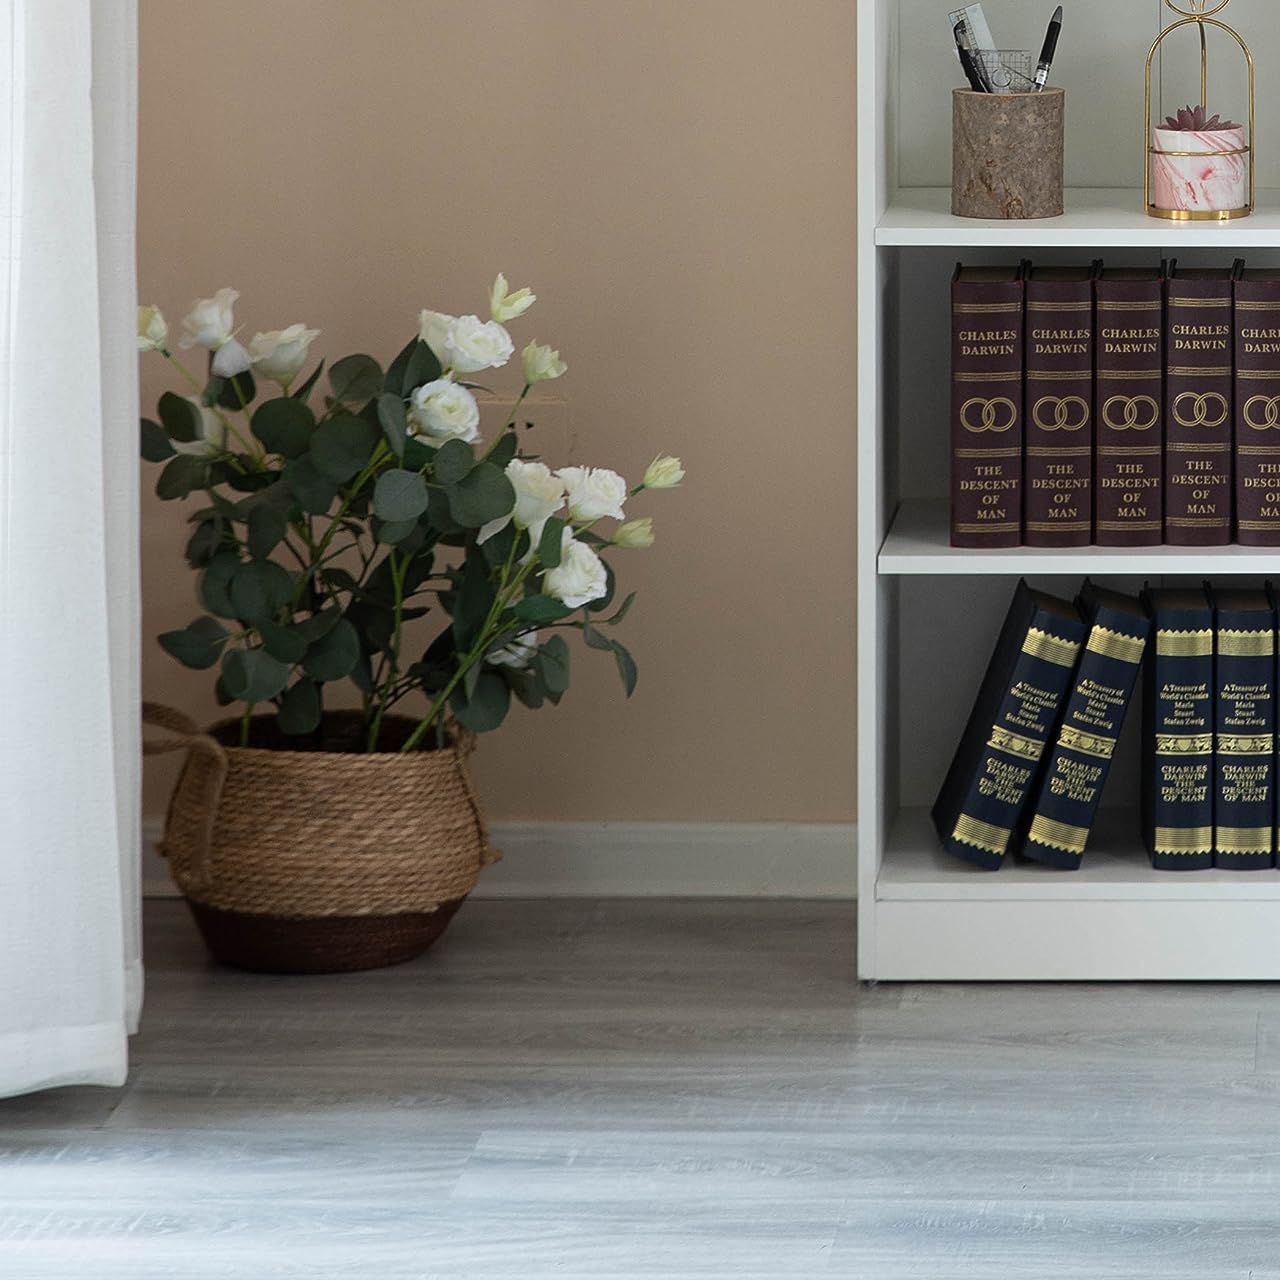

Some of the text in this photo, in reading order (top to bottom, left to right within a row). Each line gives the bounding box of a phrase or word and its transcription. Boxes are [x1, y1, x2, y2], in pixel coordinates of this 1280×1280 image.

[1033, 329, 1090, 338] CHARLES
[1102, 329, 1159, 338] CHARLES
[1172, 325, 1228, 334] CHARLES
[960, 331, 1016, 340] CHARLES
[1036, 344, 1087, 353] DARWIN
[1105, 344, 1156, 352] DARWIN
[1176, 340, 1225, 349] DARWIN
[963, 345, 1013, 354] DARWIN
[1047, 465, 1073, 474] THE
[1117, 465, 1143, 473] THE
[1187, 461, 1212, 469] THE
[975, 466, 1002, 475] THE
[1033, 479, 1088, 488] DESCENT
[1102, 479, 1159, 487] DESCENT
[1172, 475, 1225, 484] DESCENT
[961, 480, 1018, 489] DESCENT
[1055, 495, 1071, 503] OF
[1124, 494, 1140, 502] OF
[1194, 490, 1209, 499] OF
[983, 496, 999, 504] OF
[977, 509, 1005, 518] MAN
[1049, 508, 1077, 517] MAN
[1118, 508, 1146, 516] MAN
[1189, 505, 1215, 513] MAN
[1161, 765, 1207, 773] CHARLES
[1161, 786, 1208, 794] DESCENT
